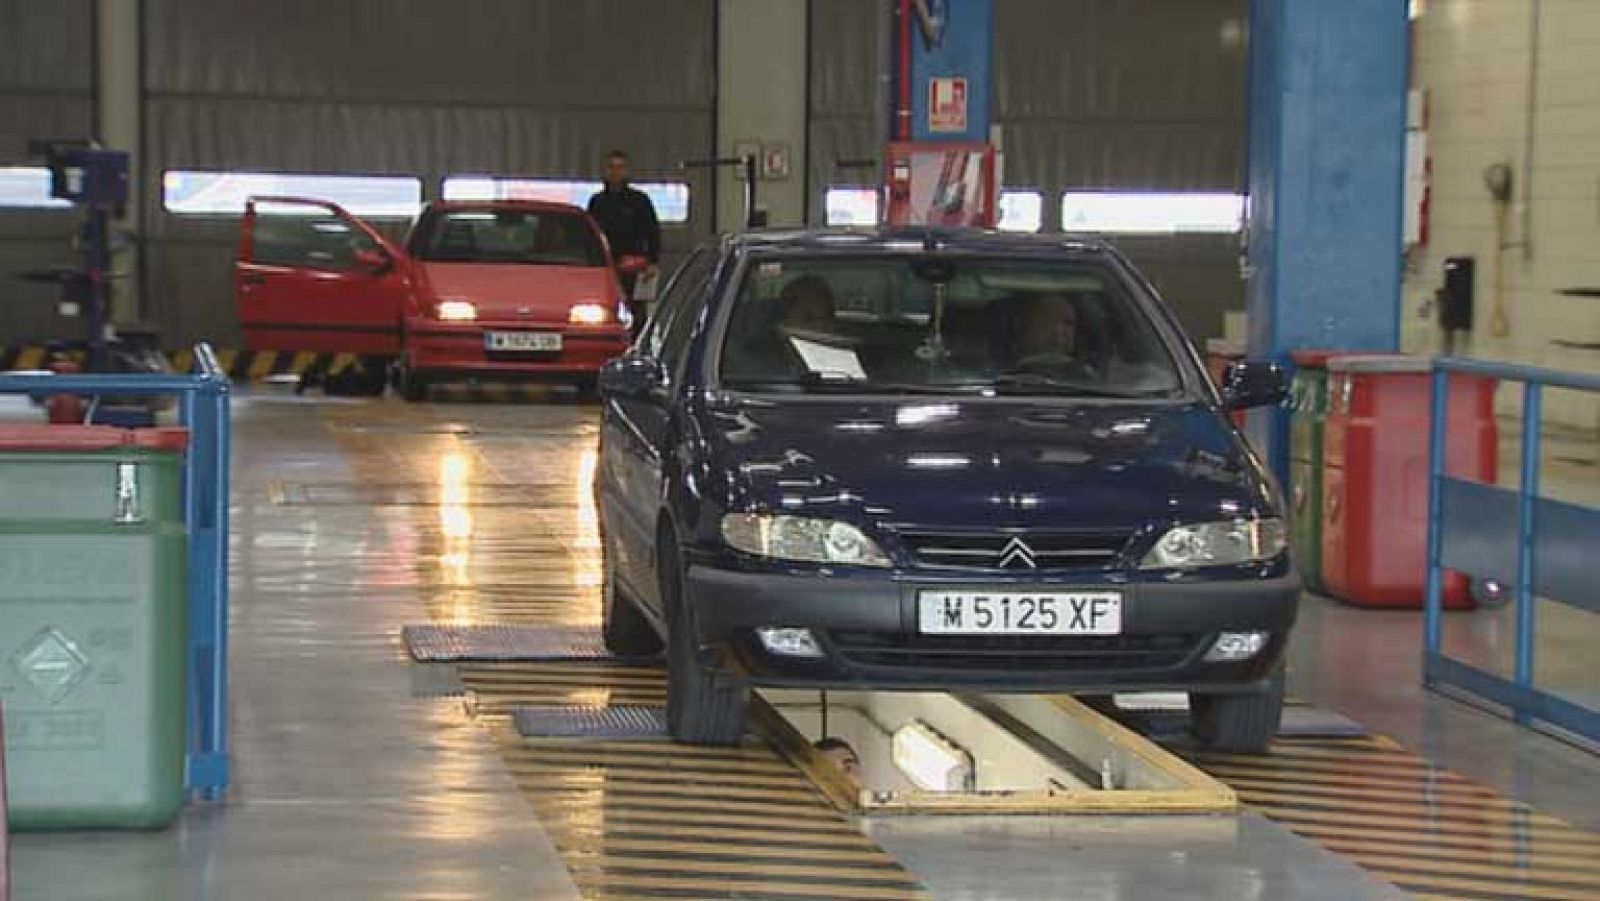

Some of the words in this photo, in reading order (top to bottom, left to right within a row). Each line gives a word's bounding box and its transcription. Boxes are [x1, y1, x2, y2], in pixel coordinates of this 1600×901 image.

[943, 596, 962, 628] M
[974, 596, 1058, 629] 5125
[1069, 597, 1110, 629] XF
